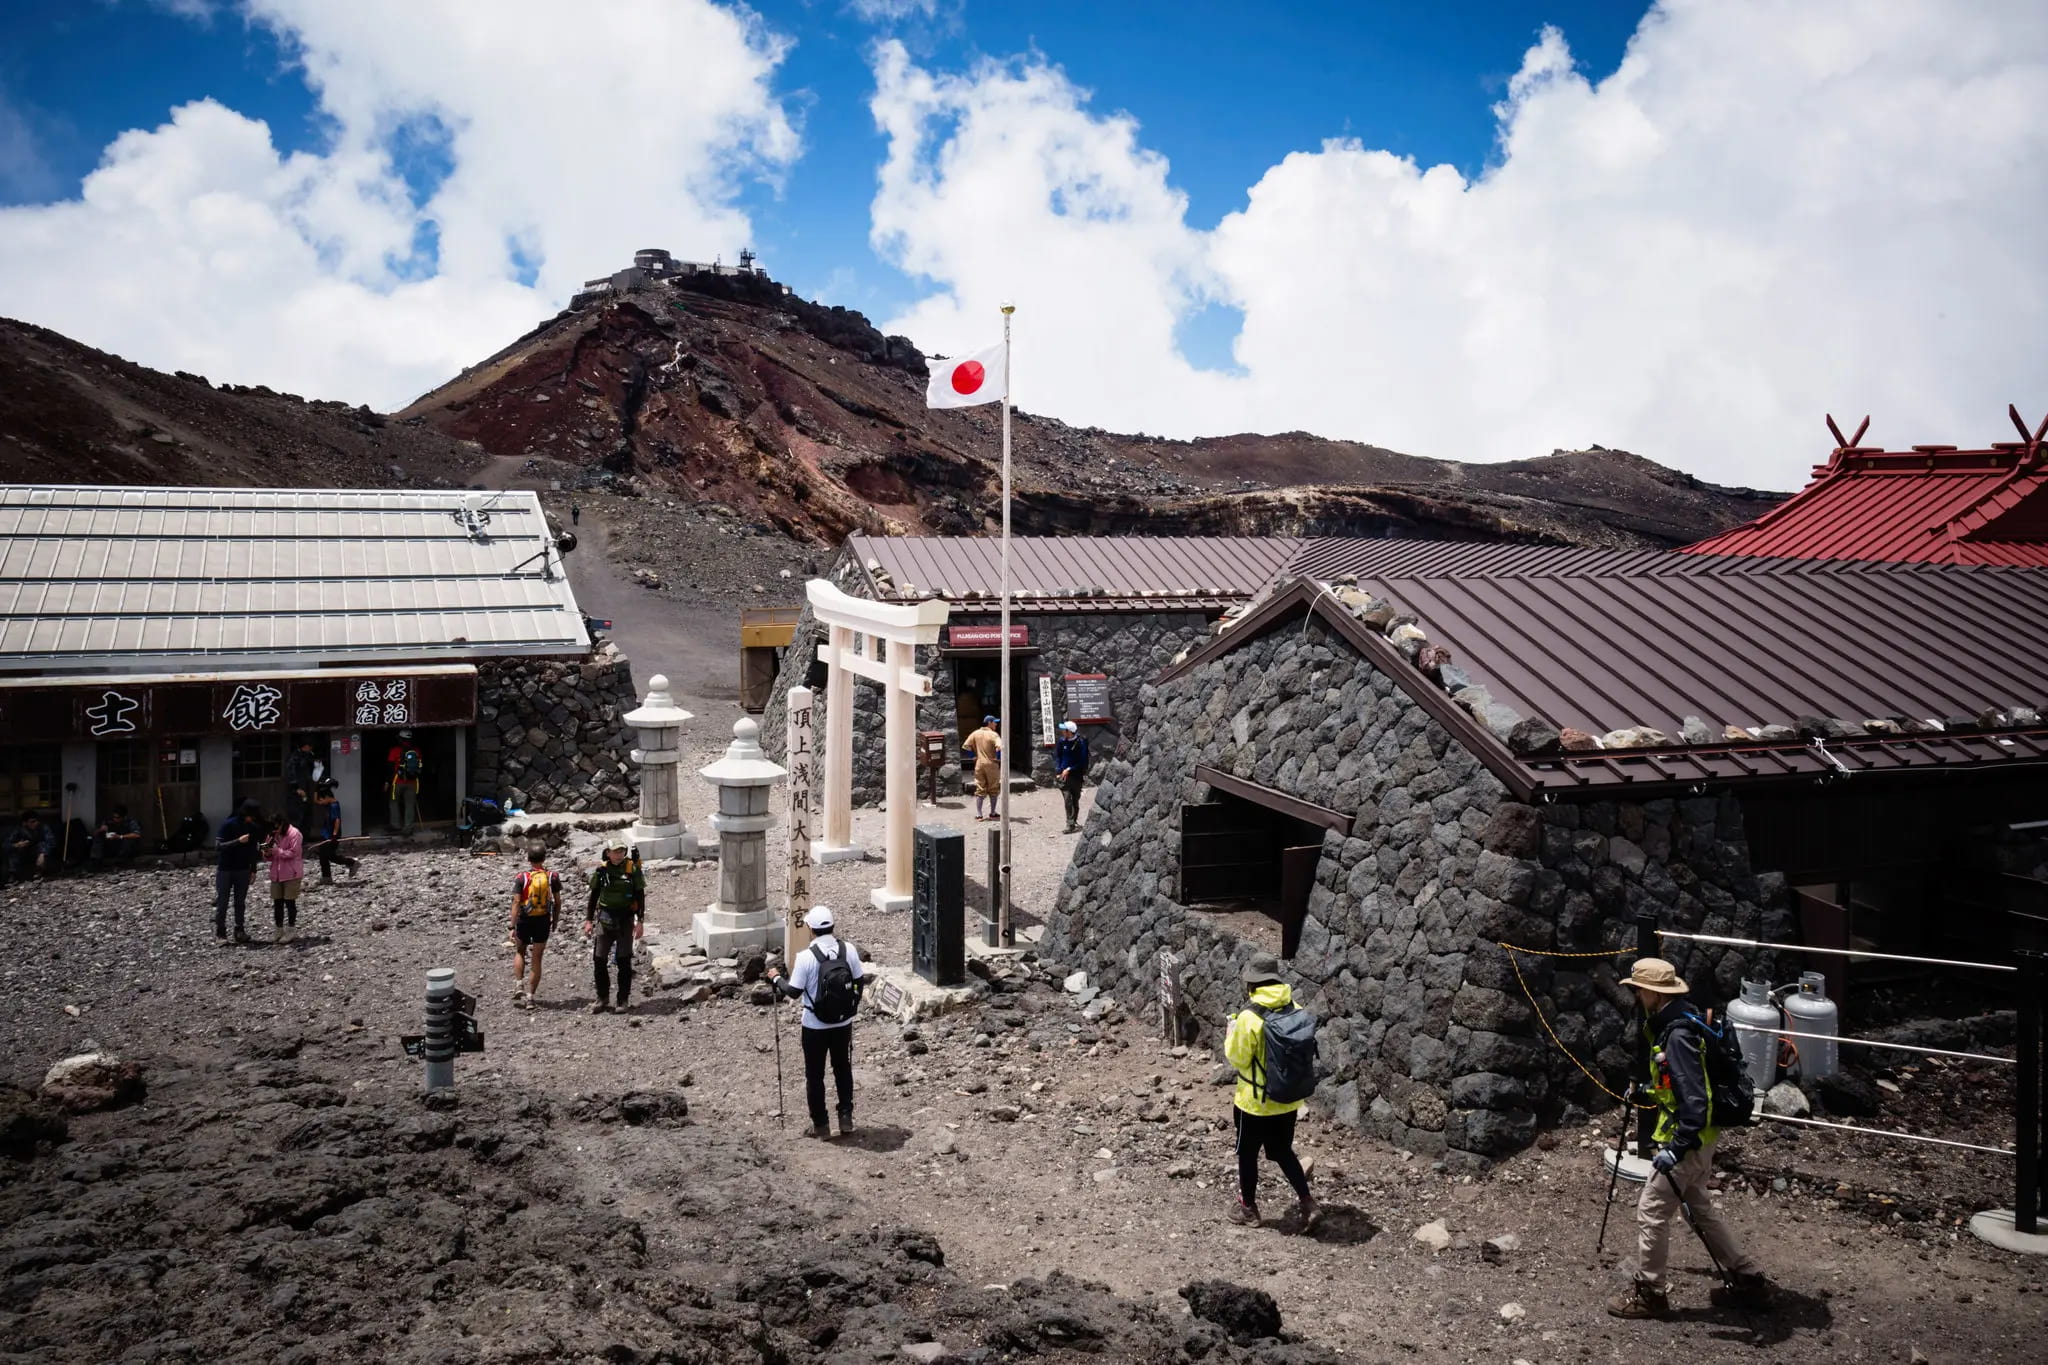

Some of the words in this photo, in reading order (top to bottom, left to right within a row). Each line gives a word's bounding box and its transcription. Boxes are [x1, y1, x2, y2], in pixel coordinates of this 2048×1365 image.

[356, 680, 407, 702] 売店
[86, 691, 139, 736] 士
[223, 684, 282, 731] 館
[356, 703, 408, 725] 宿泊
[790, 706, 812, 929] 頂上浅間大社奥宮
